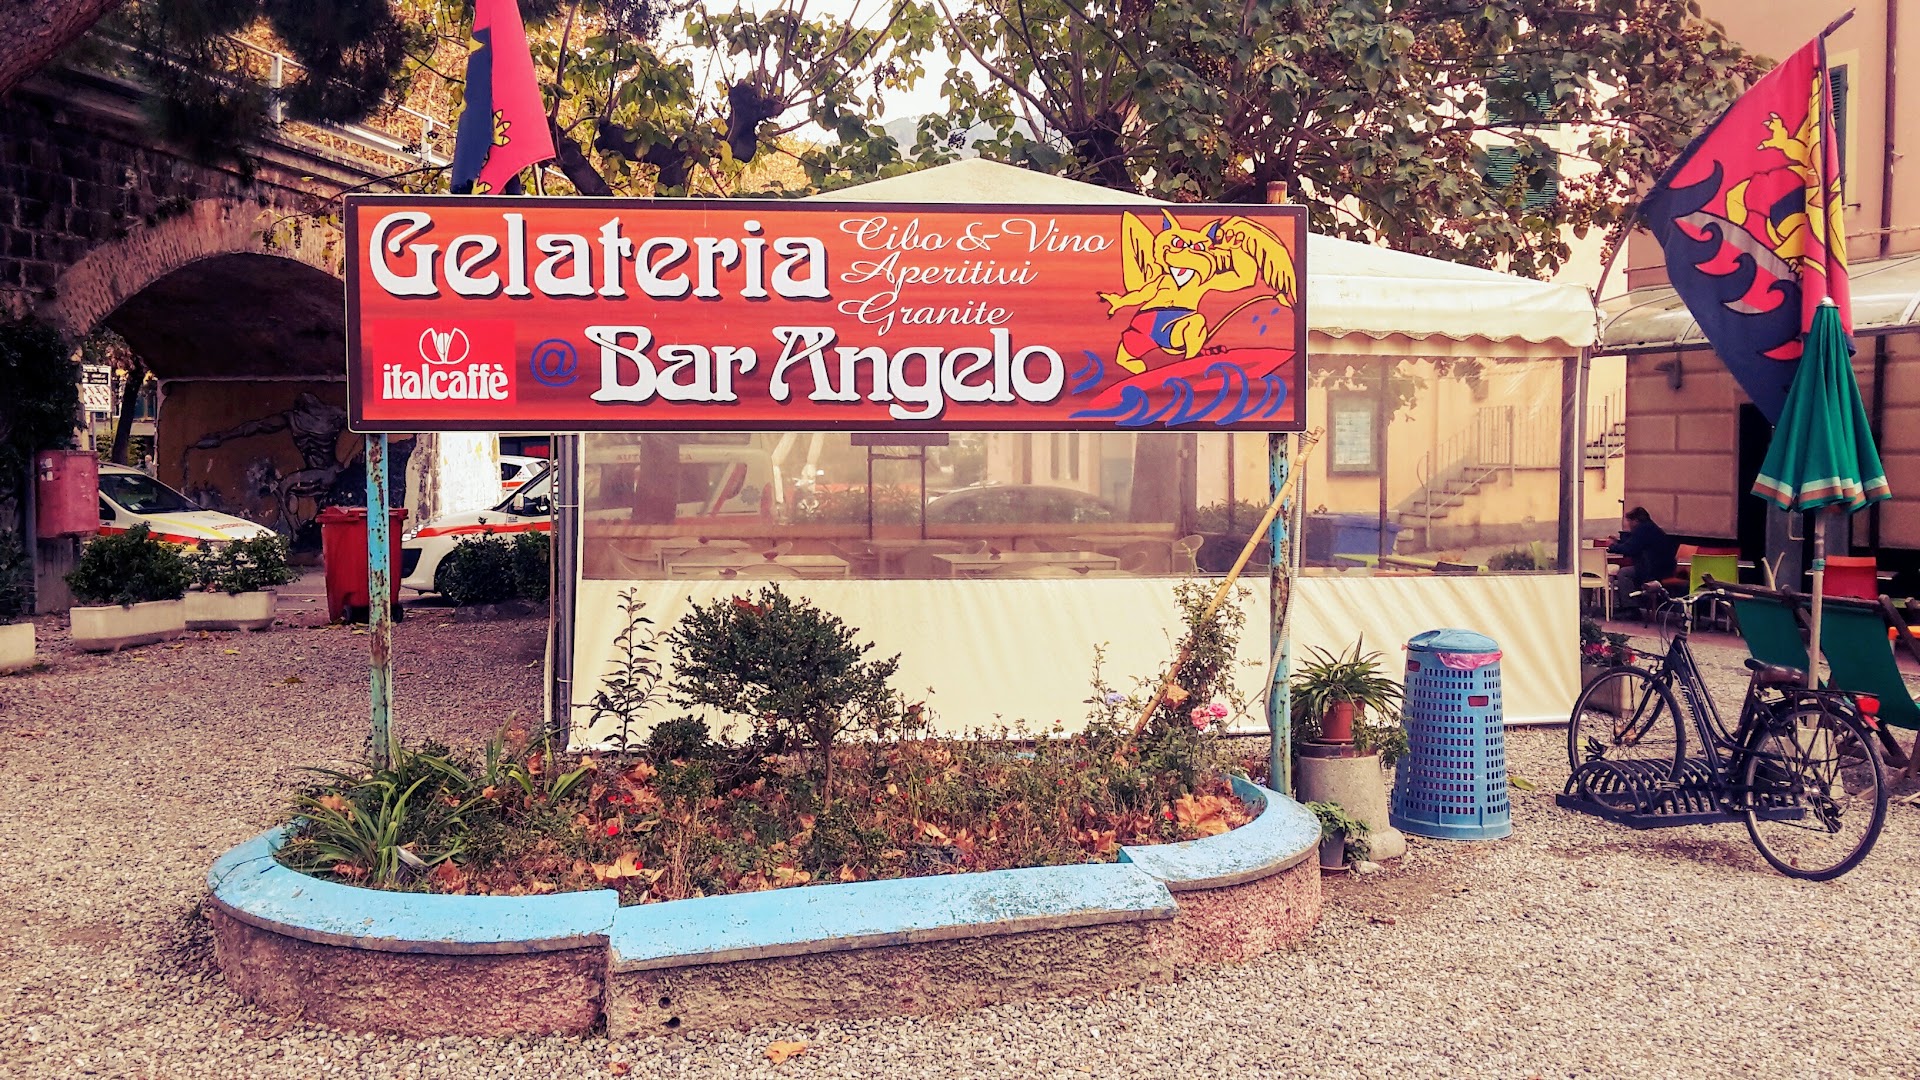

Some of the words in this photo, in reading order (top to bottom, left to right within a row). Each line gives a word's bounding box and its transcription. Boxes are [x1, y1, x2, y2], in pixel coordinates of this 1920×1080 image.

[368, 210, 831, 298] Gelateria
[839, 215, 952, 252] Cibo
[957, 221, 1000, 252] &
[1001, 217, 1115, 254] Vino
[840, 251, 1038, 302] Aperitivi
[837, 290, 1014, 337] Granite
[381, 363, 509, 401] italcaffè
[583, 325, 758, 403] Bar
[769, 326, 1066, 421] Angelo
